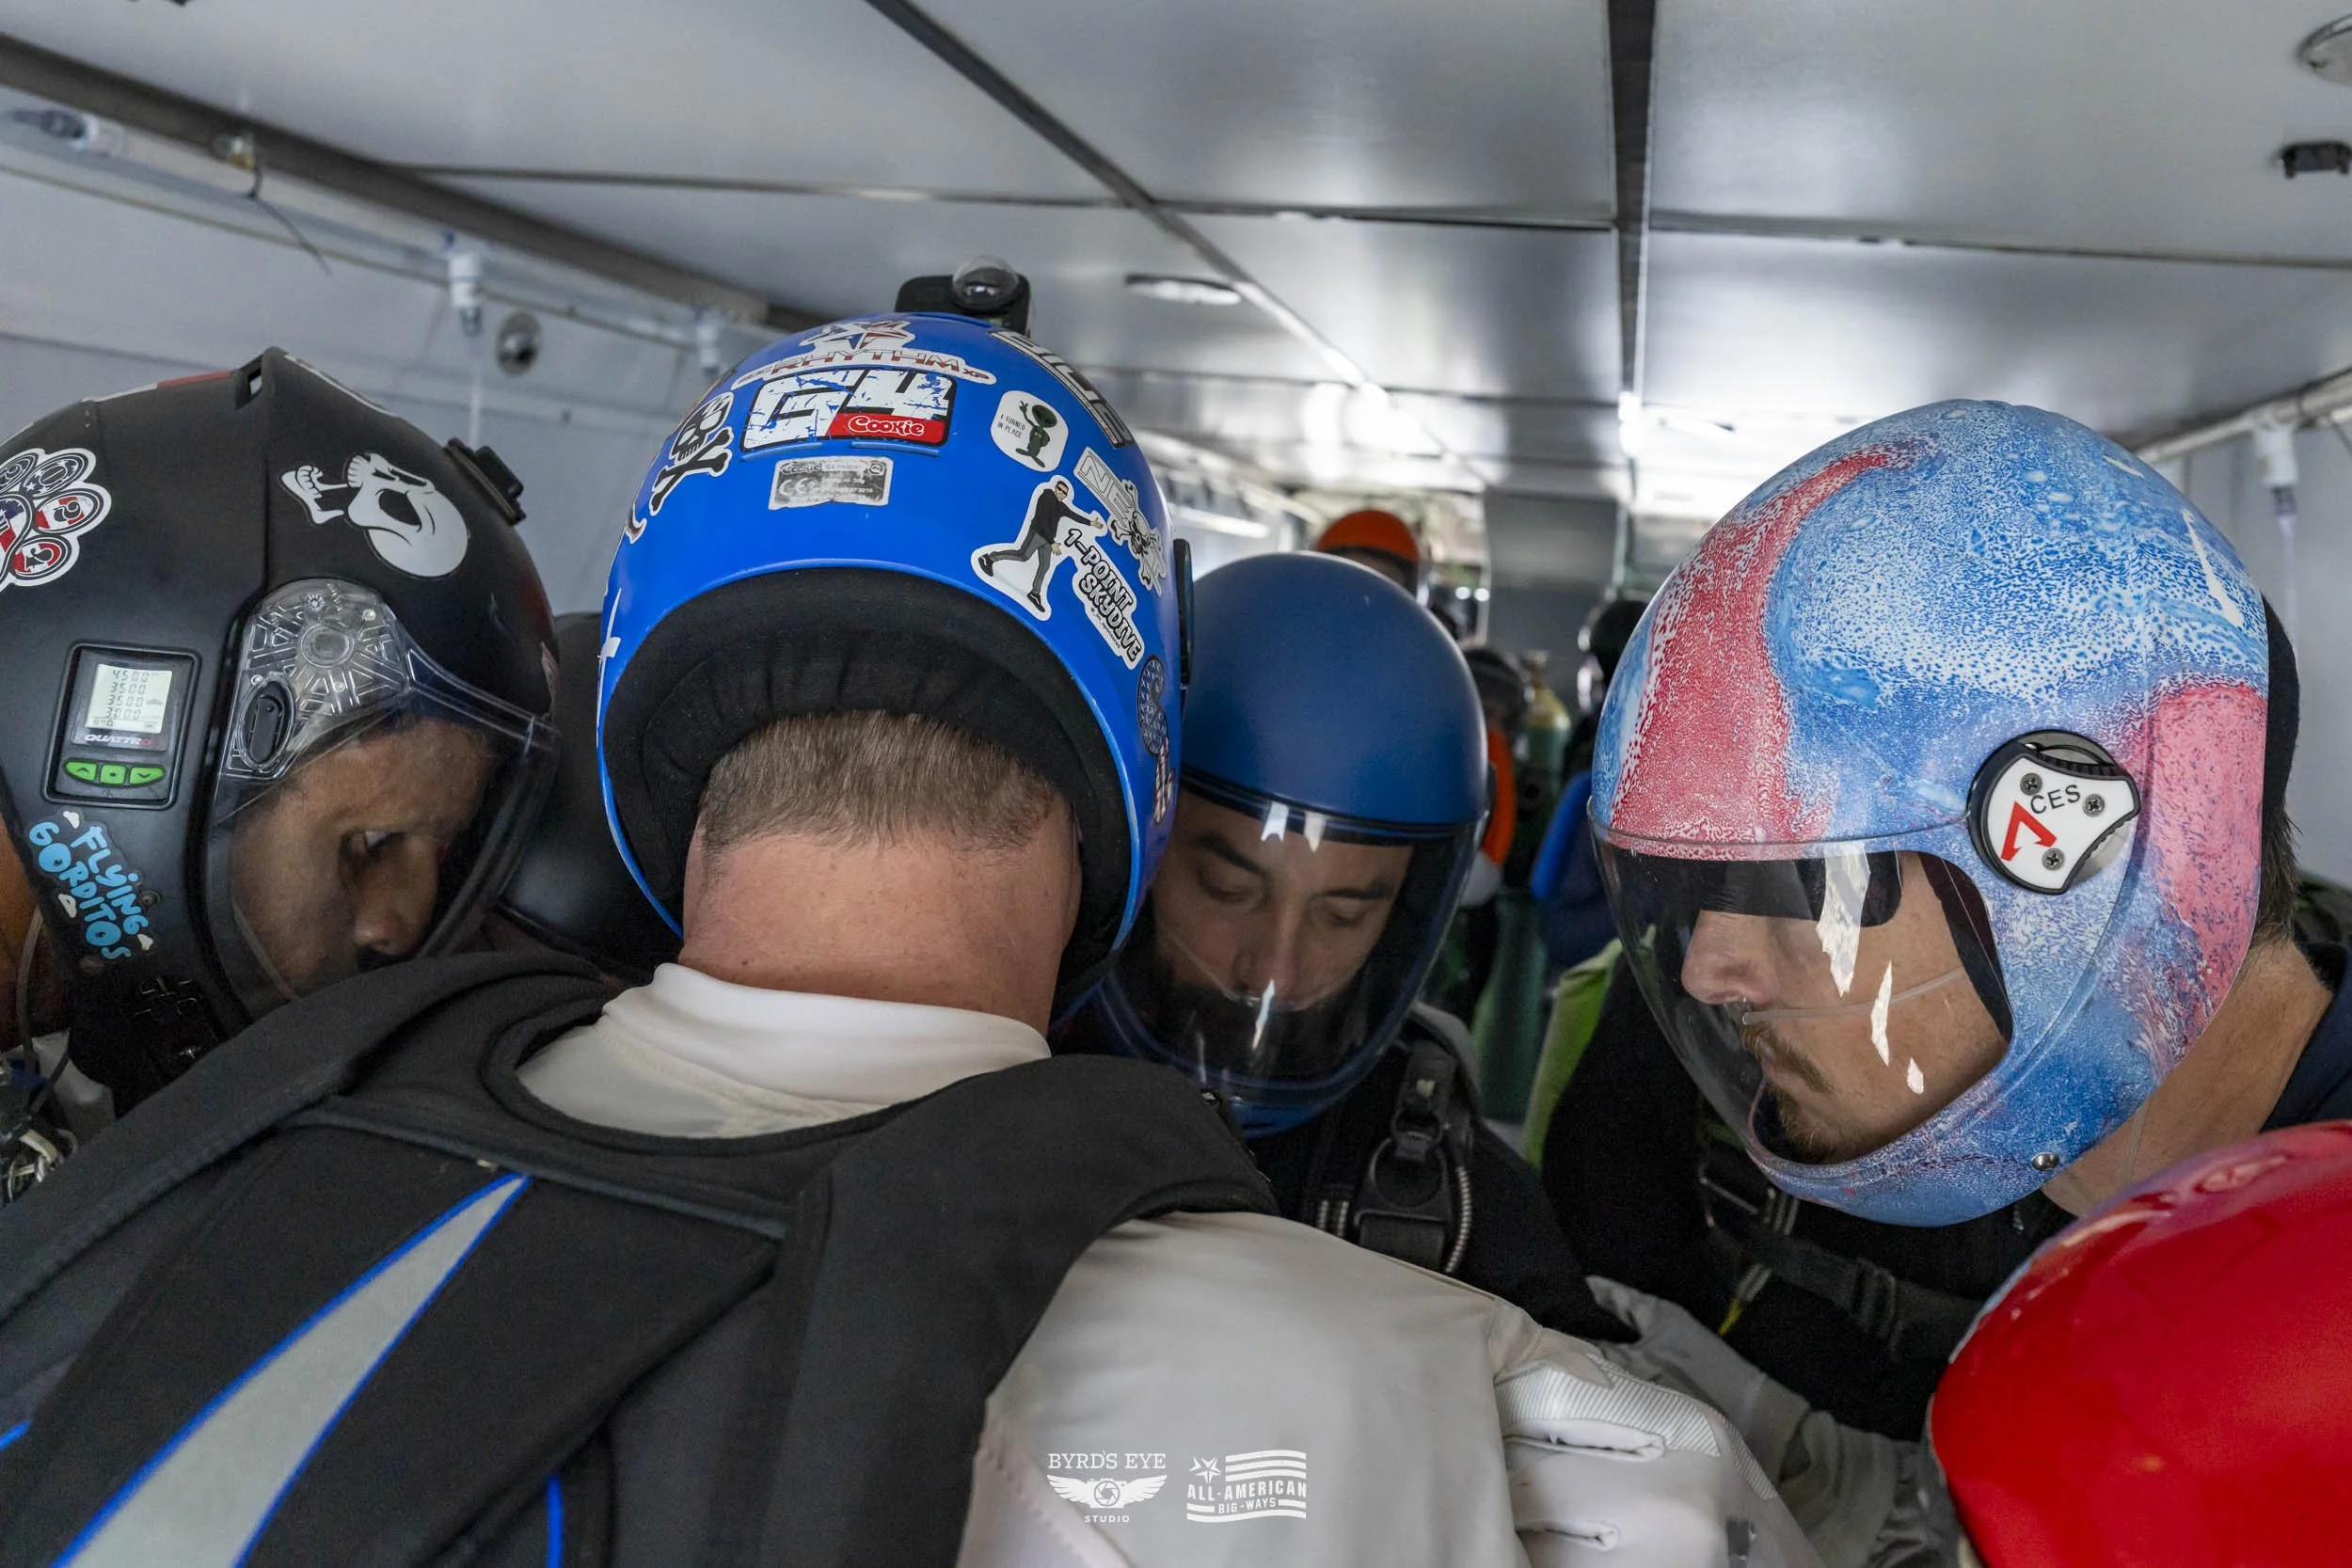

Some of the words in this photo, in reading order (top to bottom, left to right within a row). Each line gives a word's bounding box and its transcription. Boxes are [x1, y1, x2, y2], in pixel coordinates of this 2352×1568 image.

[771, 348, 961, 375] RHYTHM
[743, 368, 953, 450] G4
[848, 415, 925, 436] Cookie
[1004, 424, 1023, 437] PLACE
[1005, 416, 1025, 430] TURNED
[1064, 528, 1134, 610] 1-POINT
[1079, 573, 1142, 662] SKYDIVE
[109, 681, 147, 696] 3500
[112, 669, 151, 684] 4500
[106, 694, 144, 707] 3500
[2030, 784, 2081, 815] CES
[29, 821, 132, 959] GORDITOS
